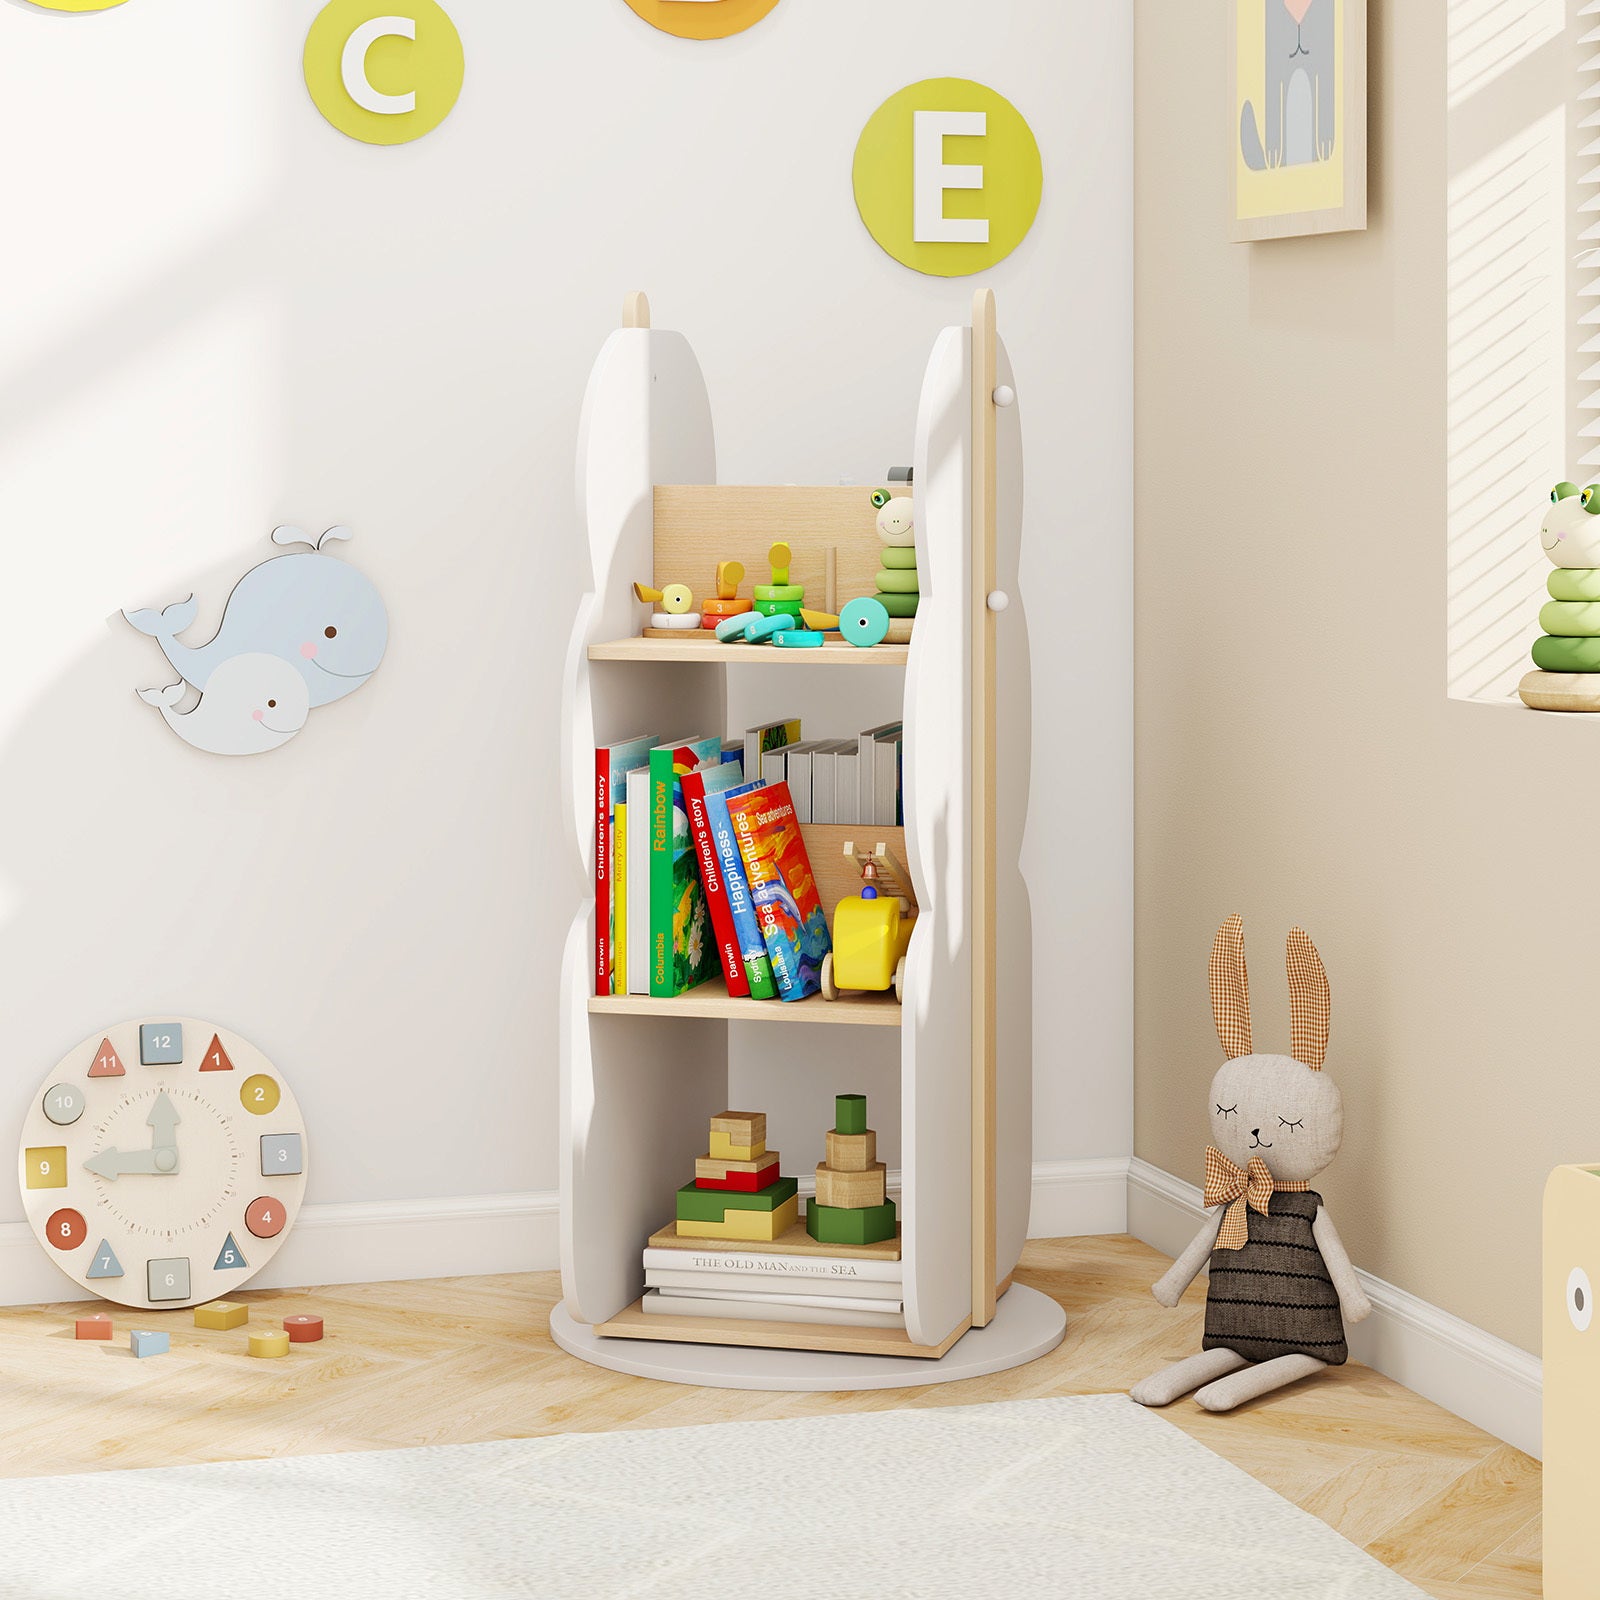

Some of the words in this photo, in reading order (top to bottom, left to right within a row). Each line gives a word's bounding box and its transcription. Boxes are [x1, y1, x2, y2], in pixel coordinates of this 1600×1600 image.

[341, 15, 416, 115] C
[914, 110, 990, 244] E
[716, 603, 723, 613] 3
[769, 604, 776, 613] 5
[778, 634, 784, 644] 8
[597, 774, 606, 808] story
[653, 781, 667, 852] Rainbow
[691, 798, 705, 828] story
[597, 812, 605, 880] Children's
[698, 831, 719, 893] Children's
[736, 812, 769, 901] adventures
[762, 903, 778, 936] Sea
[655, 933, 665, 985] Columbia
[725, 943, 739, 978] Darwin
[748, 949, 762, 983] Sydny
[774, 946, 792, 990] Louisiana
[152, 1035, 171, 1048] 12
[99, 1055, 117, 1068] 11
[212, 1053, 220, 1066] 1
[55, 1095, 73, 1108] 10
[255, 1087, 265, 1101] 2
[278, 1149, 287, 1162] 3
[39, 1161, 50, 1174] 9
[262, 1210, 272, 1223] 4
[60, 1222, 71, 1237] 8
[101, 1256, 111, 1269] 7
[224, 1250, 234, 1264] 5
[692, 1257, 721, 1268] THE
[724, 1258, 754, 1270] OLD
[757, 1261, 789, 1272] MAN
[831, 1264, 857, 1275] SEA
[165, 1273, 174, 1285] 6
